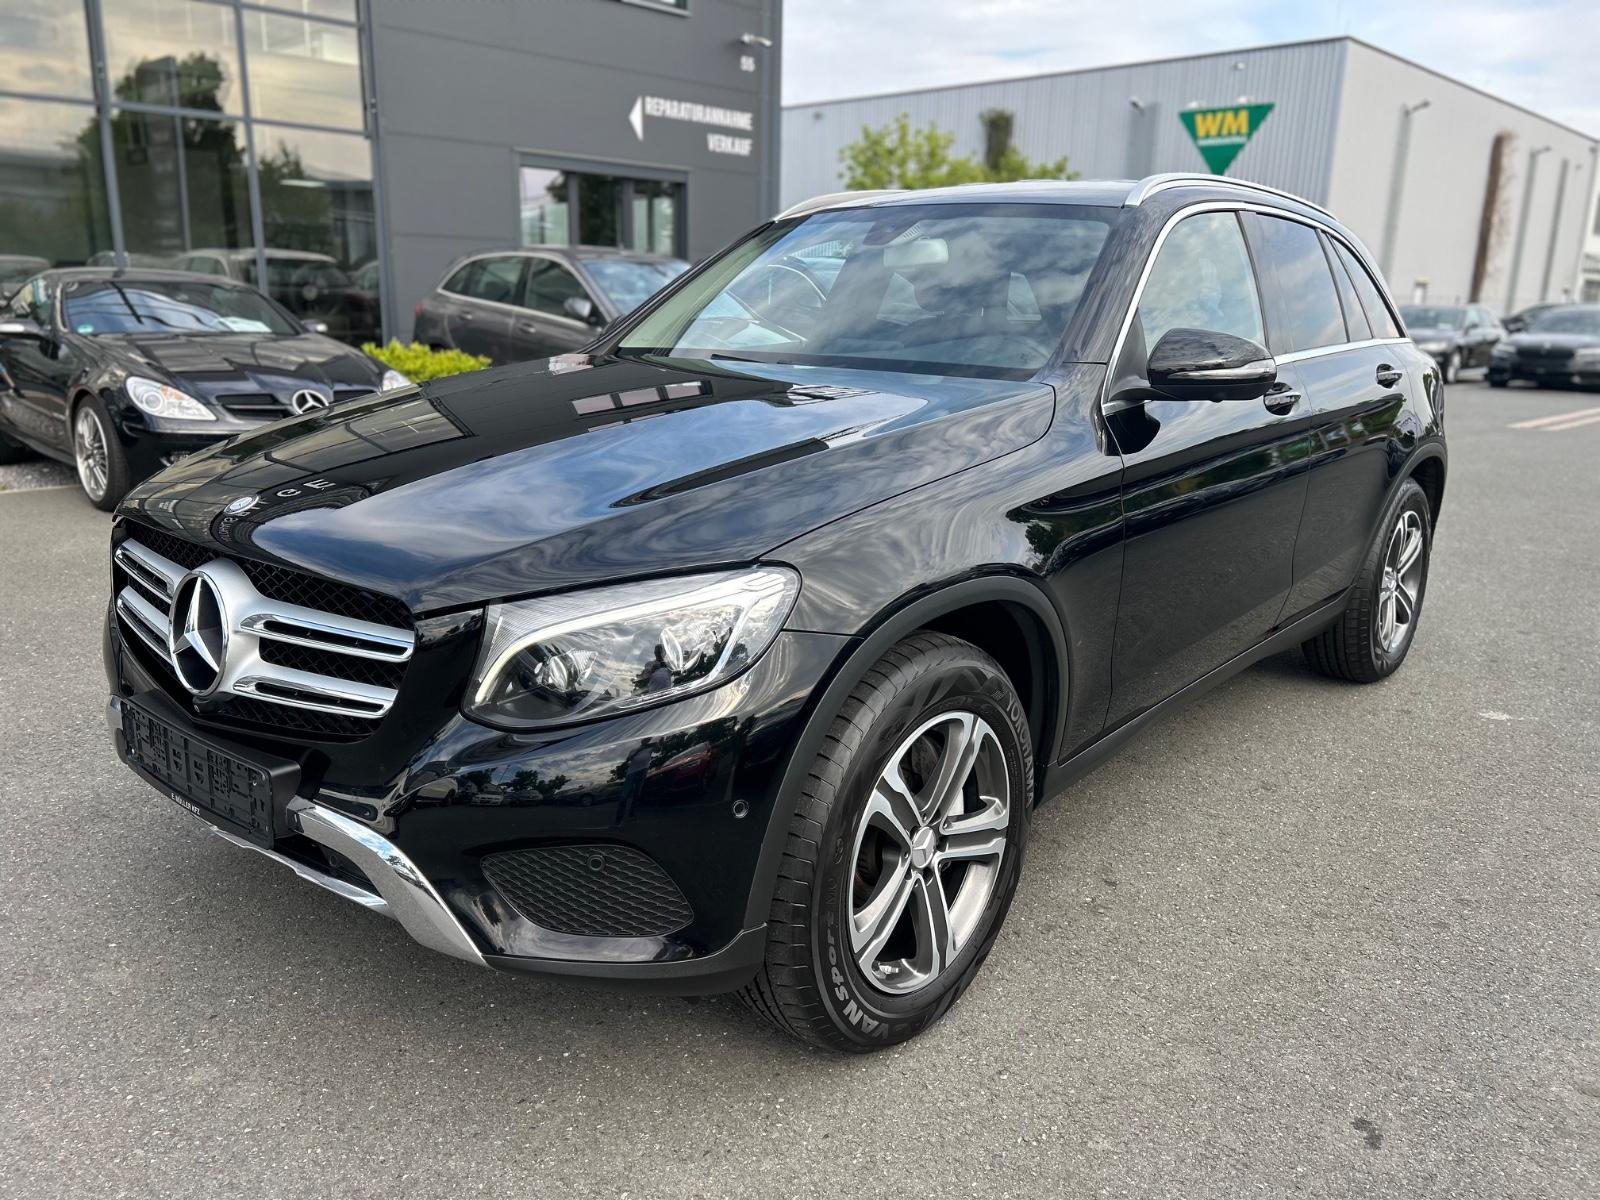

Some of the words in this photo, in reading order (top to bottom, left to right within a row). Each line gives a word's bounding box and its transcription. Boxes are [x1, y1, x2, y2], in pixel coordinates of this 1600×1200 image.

[644, 95, 752, 131] REPARATURANNAHME
[1195, 108, 1249, 138] WM
[707, 133, 752, 156] VERKAUF
